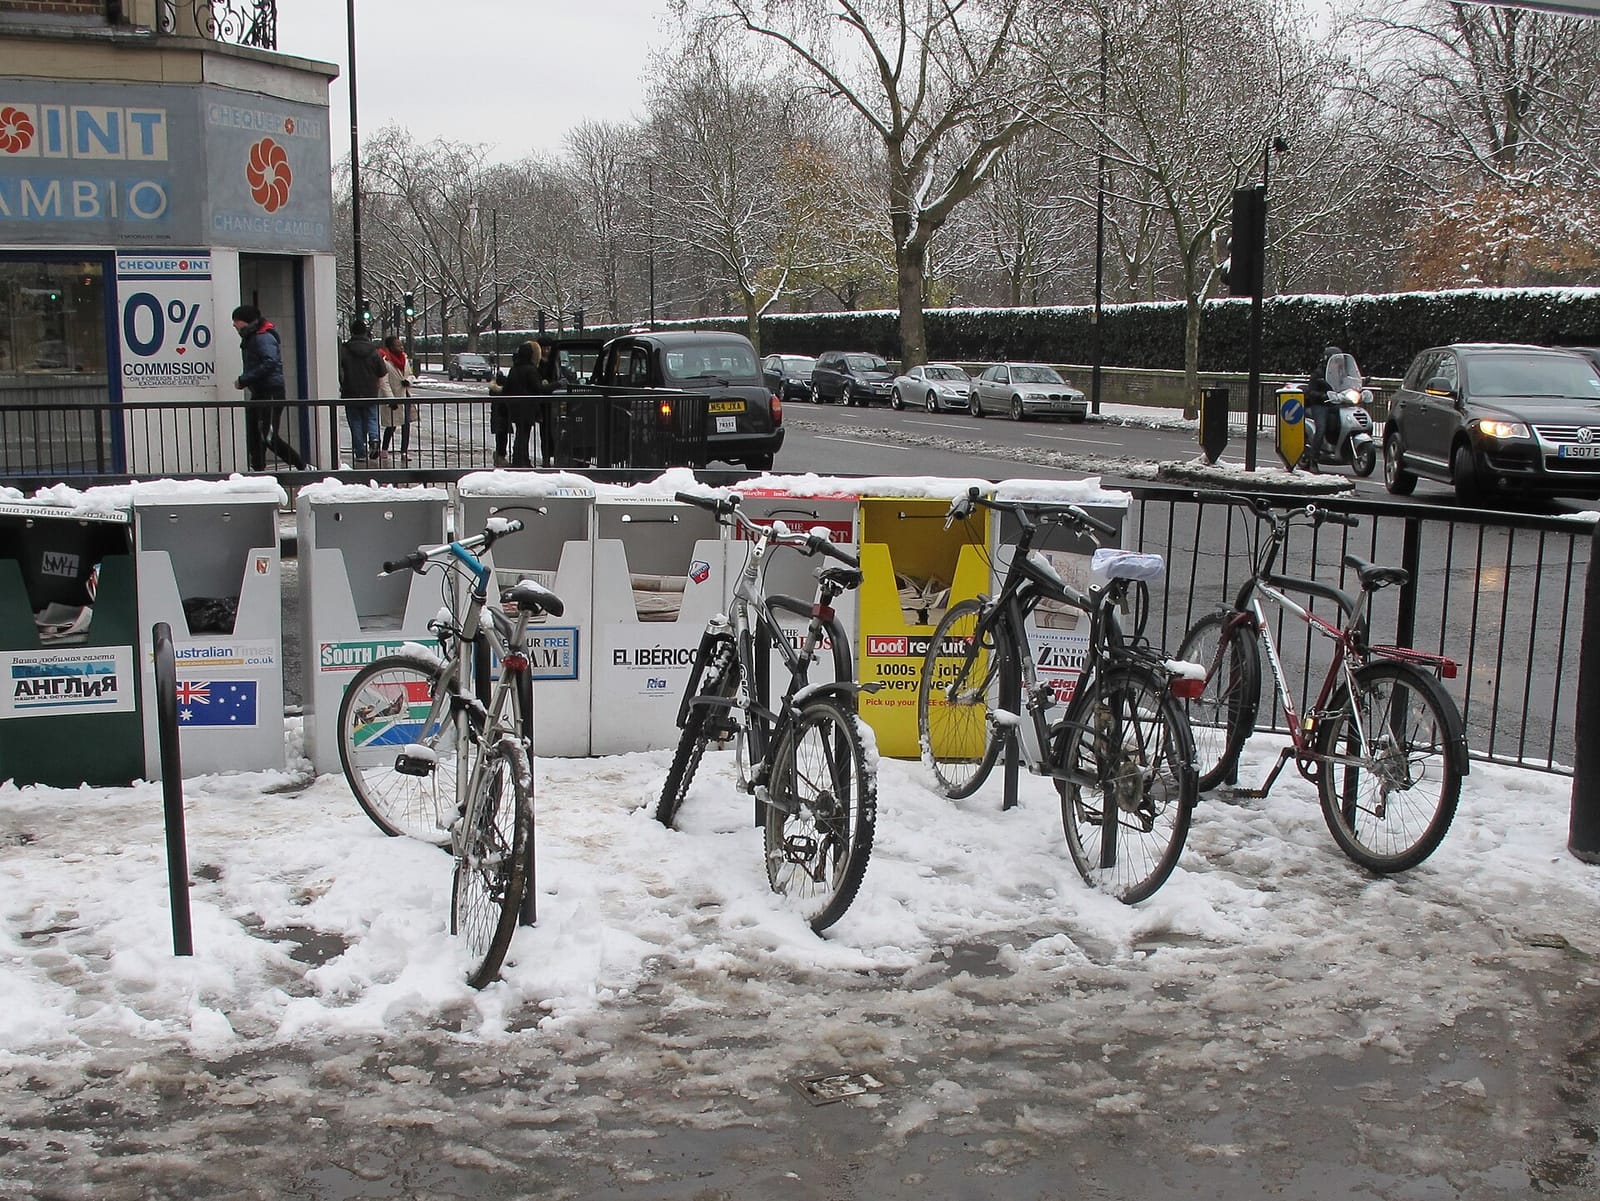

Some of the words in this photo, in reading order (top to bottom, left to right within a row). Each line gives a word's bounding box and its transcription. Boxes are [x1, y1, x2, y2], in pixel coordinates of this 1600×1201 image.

[124, 292, 211, 356] 0%
[123, 361, 215, 376] COMMISSION
[1566, 447, 1591, 457] LS07
[787, 522, 804, 530] THE
[781, 629, 799, 637] THE
[543, 638, 569, 647] FREE
[870, 639, 904, 654] Loot
[12, 657, 38, 665] Ваша
[244, 656, 274, 665] .co.uk
[321, 646, 373, 665] SOUTH
[613, 649, 632, 665] EL
[1036, 642, 1085, 667] ŽINIO
[876, 664, 916, 675] 1000s
[938, 663, 969, 678] job
[14, 676, 118, 697] АНГЛИЯ
[646, 678, 667, 689] Ria
[879, 680, 919, 693] every
[866, 698, 882, 706] Pick
[884, 700, 896, 708] up
[897, 700, 916, 708] your
